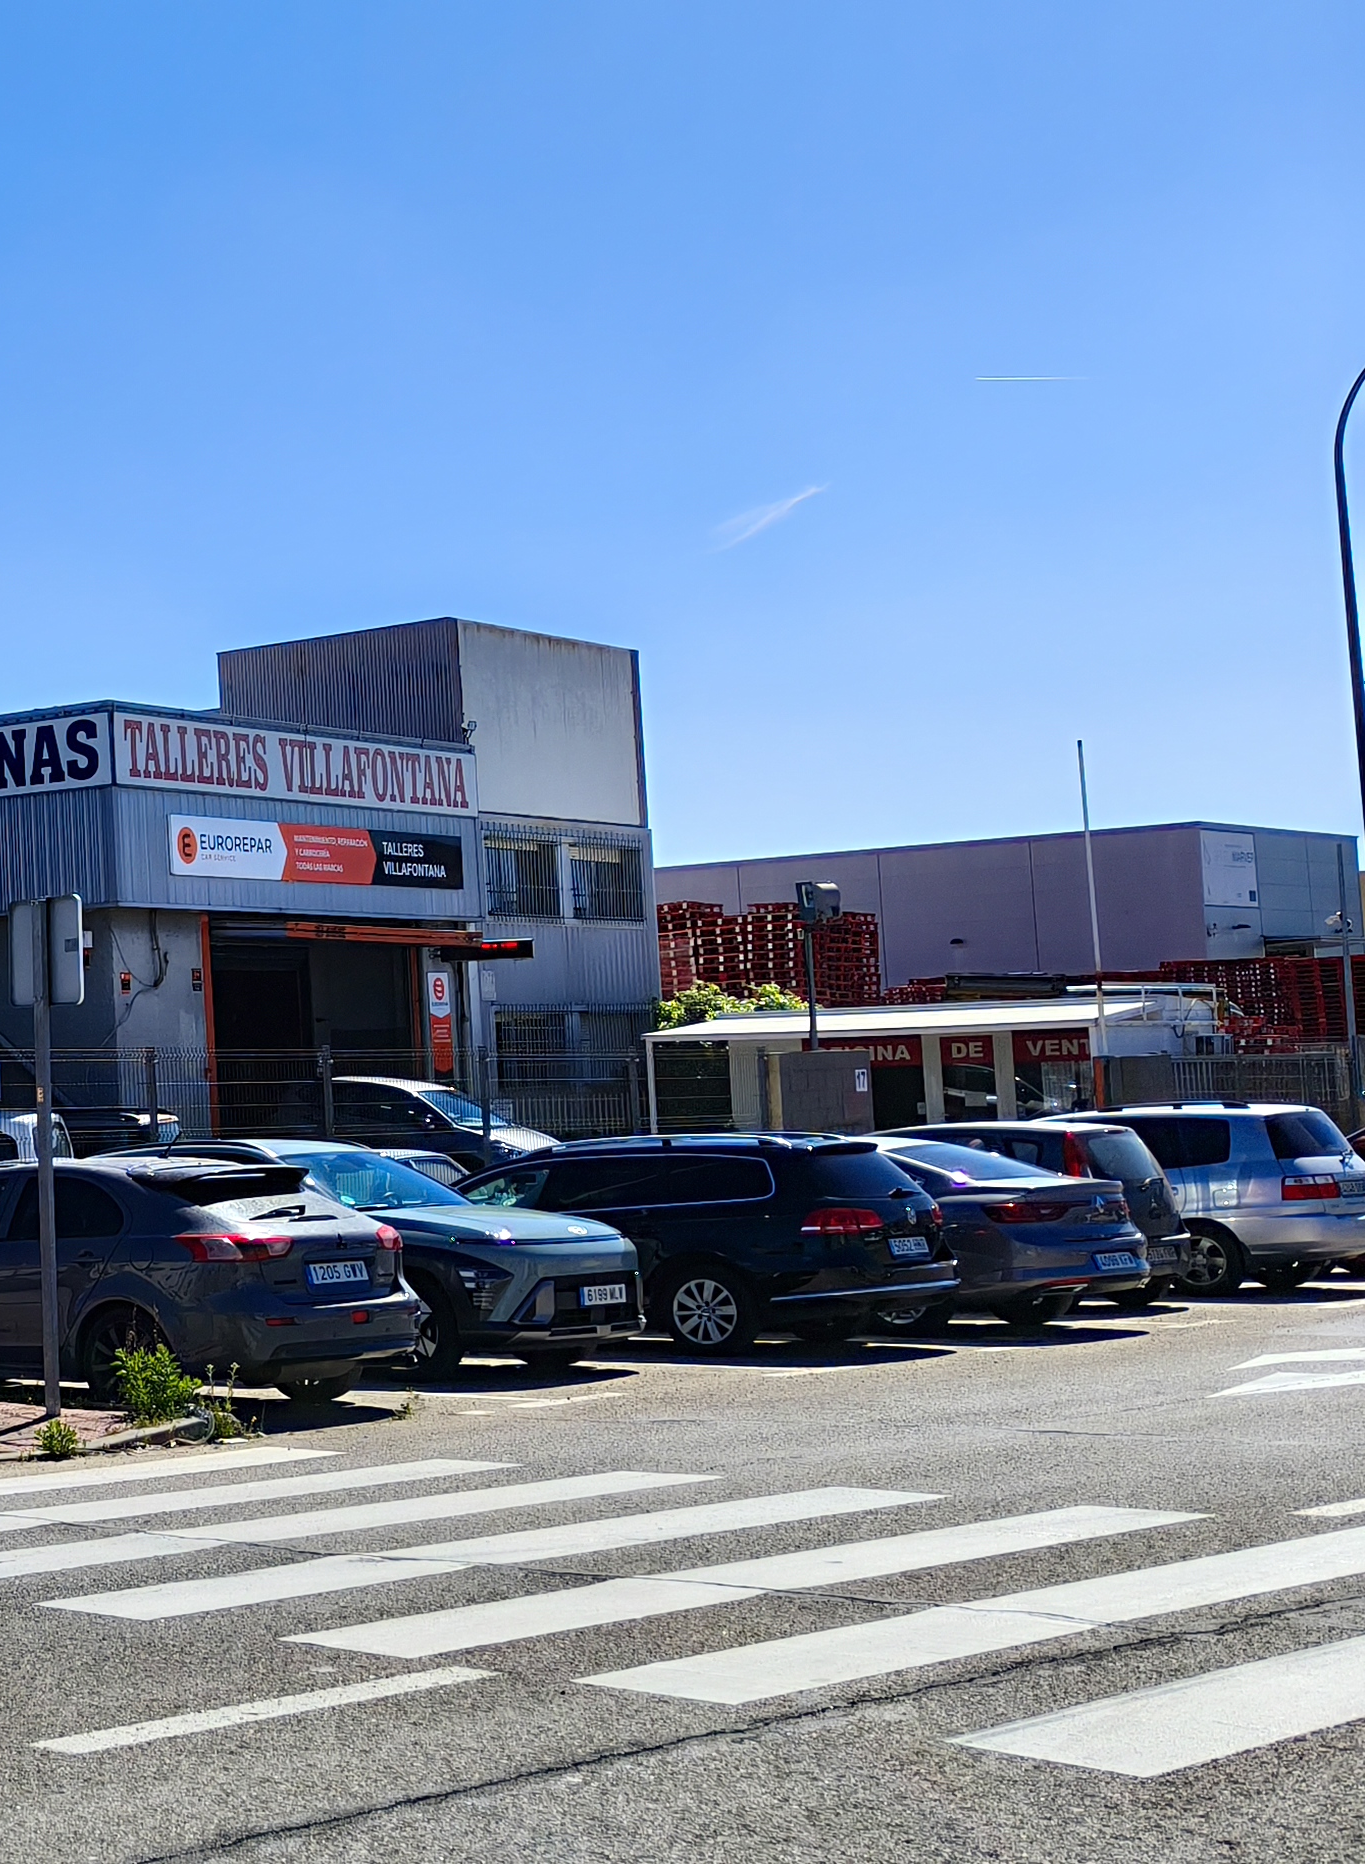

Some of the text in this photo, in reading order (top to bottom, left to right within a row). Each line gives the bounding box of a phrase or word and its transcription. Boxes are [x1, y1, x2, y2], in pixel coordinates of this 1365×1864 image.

[124, 719, 469, 808] TALLERES VILLAFONTANA
[199, 834, 273, 854] EUROREPAR
[382, 841, 424, 857] TALLERES
[383, 861, 446, 877] VILLAFONTANA
[952, 1041, 984, 1058] DE
[313, 1265, 341, 1281] 1205
[587, 1288, 608, 1302] 6199
